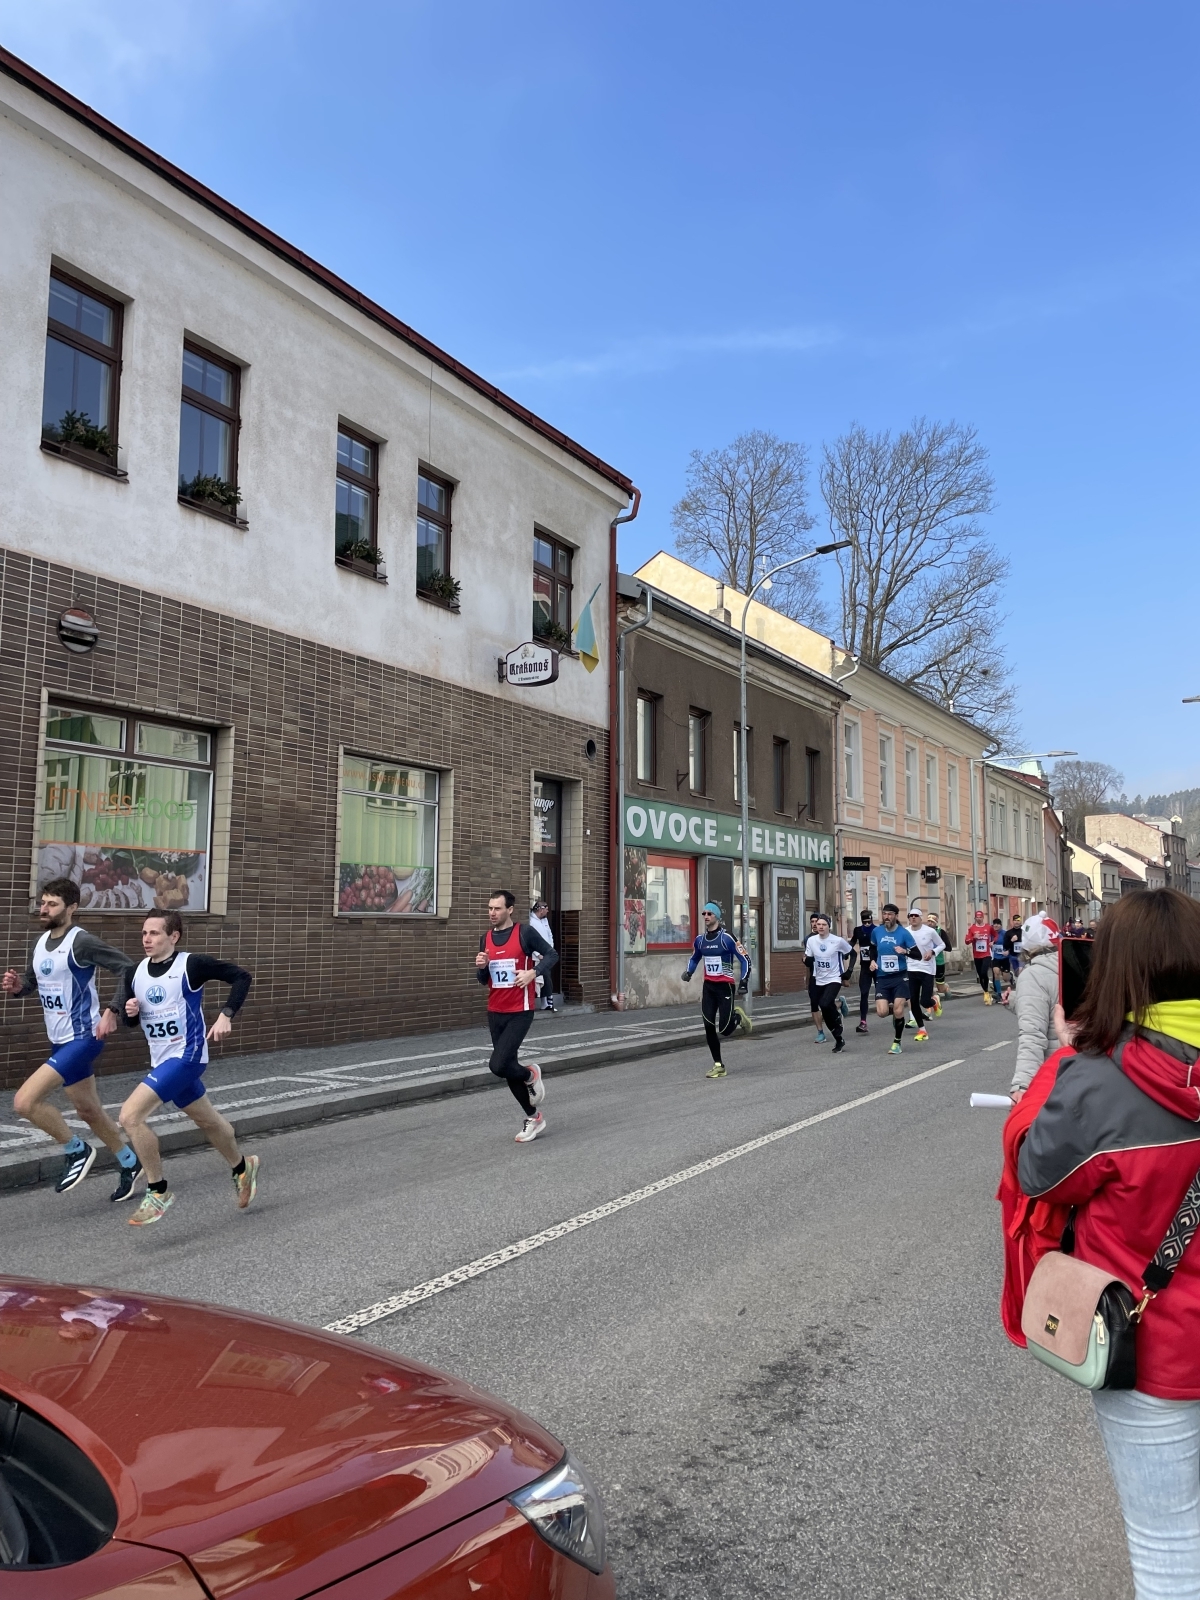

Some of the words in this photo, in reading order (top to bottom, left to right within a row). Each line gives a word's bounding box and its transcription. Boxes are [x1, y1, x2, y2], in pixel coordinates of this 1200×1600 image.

[509, 659, 549, 675] Krakonoš
[49, 787, 132, 816] FITNESS
[137, 797, 194, 821] FOOD
[94, 817, 155, 842] MENU
[626, 805, 718, 848] OVOCE
[495, 971, 508, 982] 12
[706, 964, 720, 972] 317
[40, 995, 63, 1009] 264
[146, 1020, 179, 1038] 236
